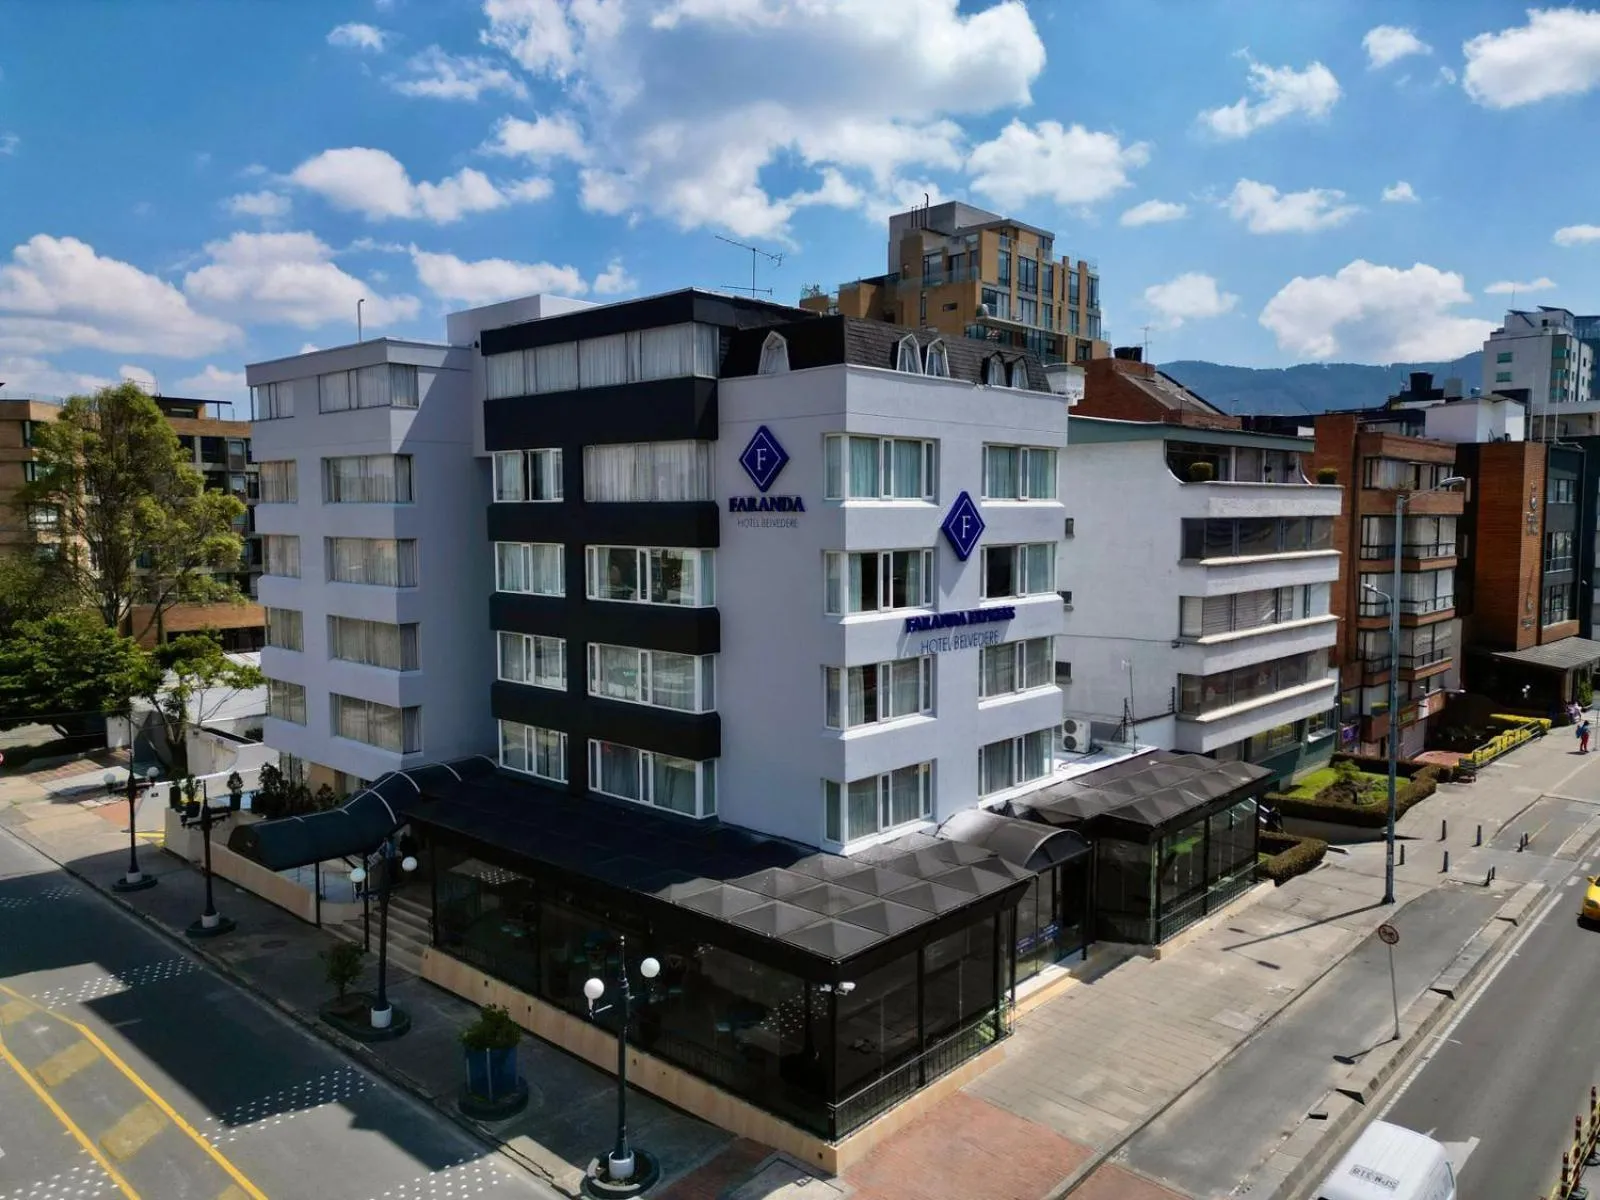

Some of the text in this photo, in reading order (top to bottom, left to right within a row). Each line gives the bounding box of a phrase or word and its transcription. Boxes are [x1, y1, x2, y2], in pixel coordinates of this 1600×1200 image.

[756, 448, 767, 470] F
[729, 496, 806, 512] FARANDA
[962, 515, 971, 538] F
[905, 611, 967, 633] FARANDA
[920, 631, 999, 654] HOTEL BELVEDERE
